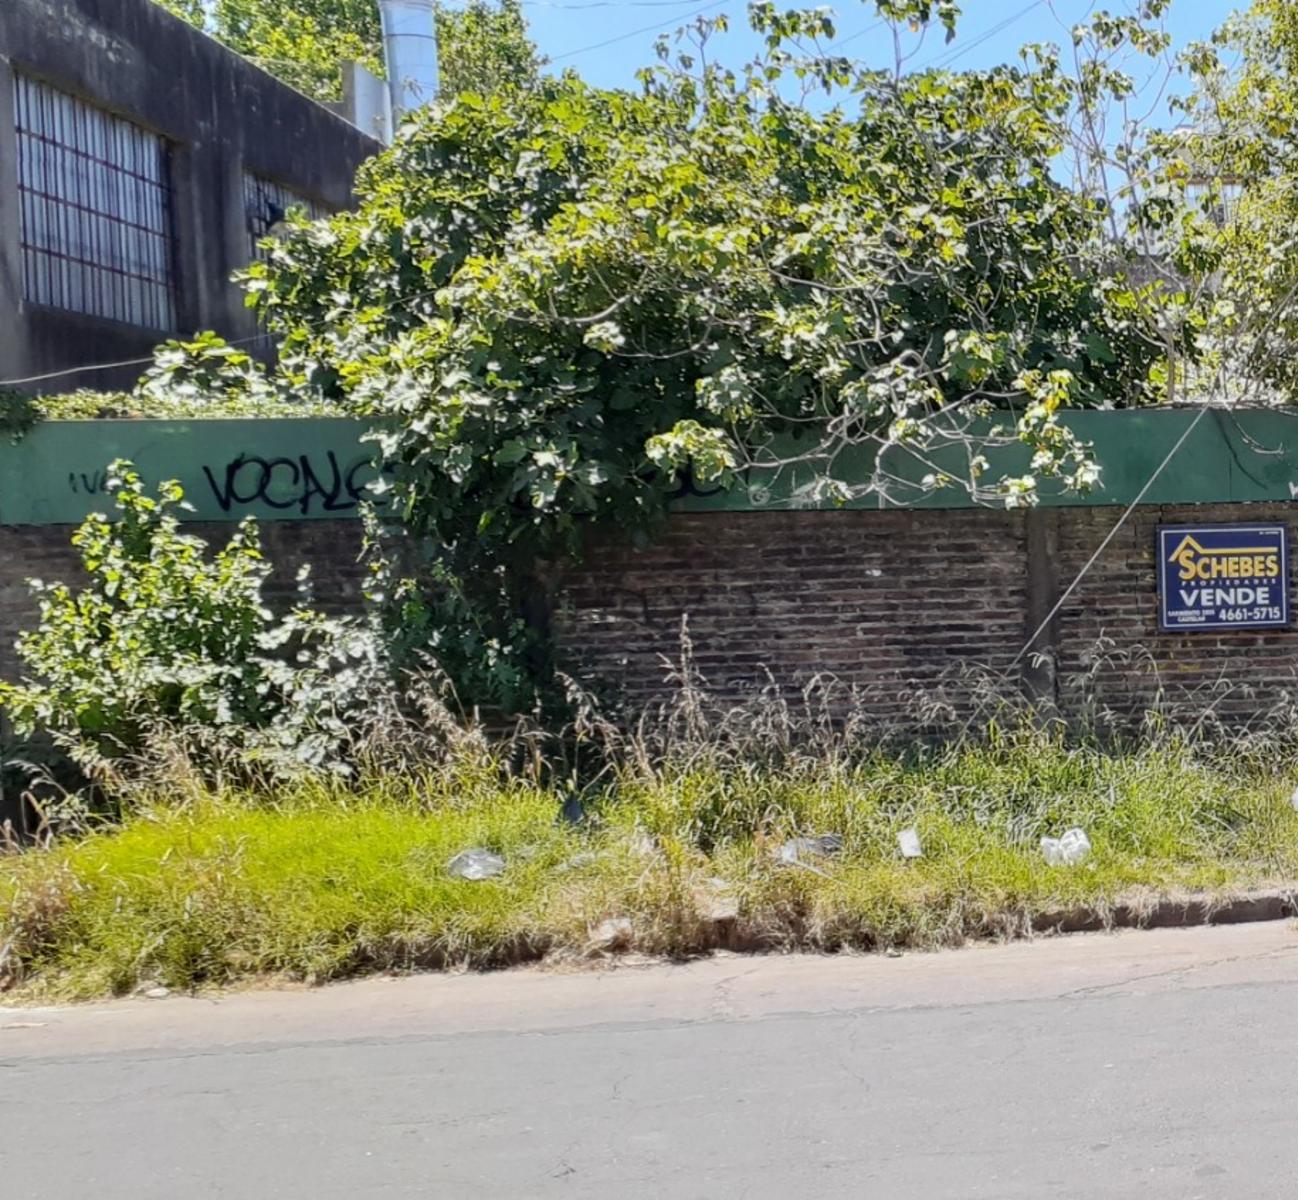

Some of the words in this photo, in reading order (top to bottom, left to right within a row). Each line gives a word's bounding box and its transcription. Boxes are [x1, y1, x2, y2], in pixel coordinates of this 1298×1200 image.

[1178, 549, 1279, 580] SCHEBES
[1181, 578, 1276, 587] PROPIEDADES
[1179, 587, 1270, 607] VENDE
[1218, 607, 1281, 621] 4661-5715
